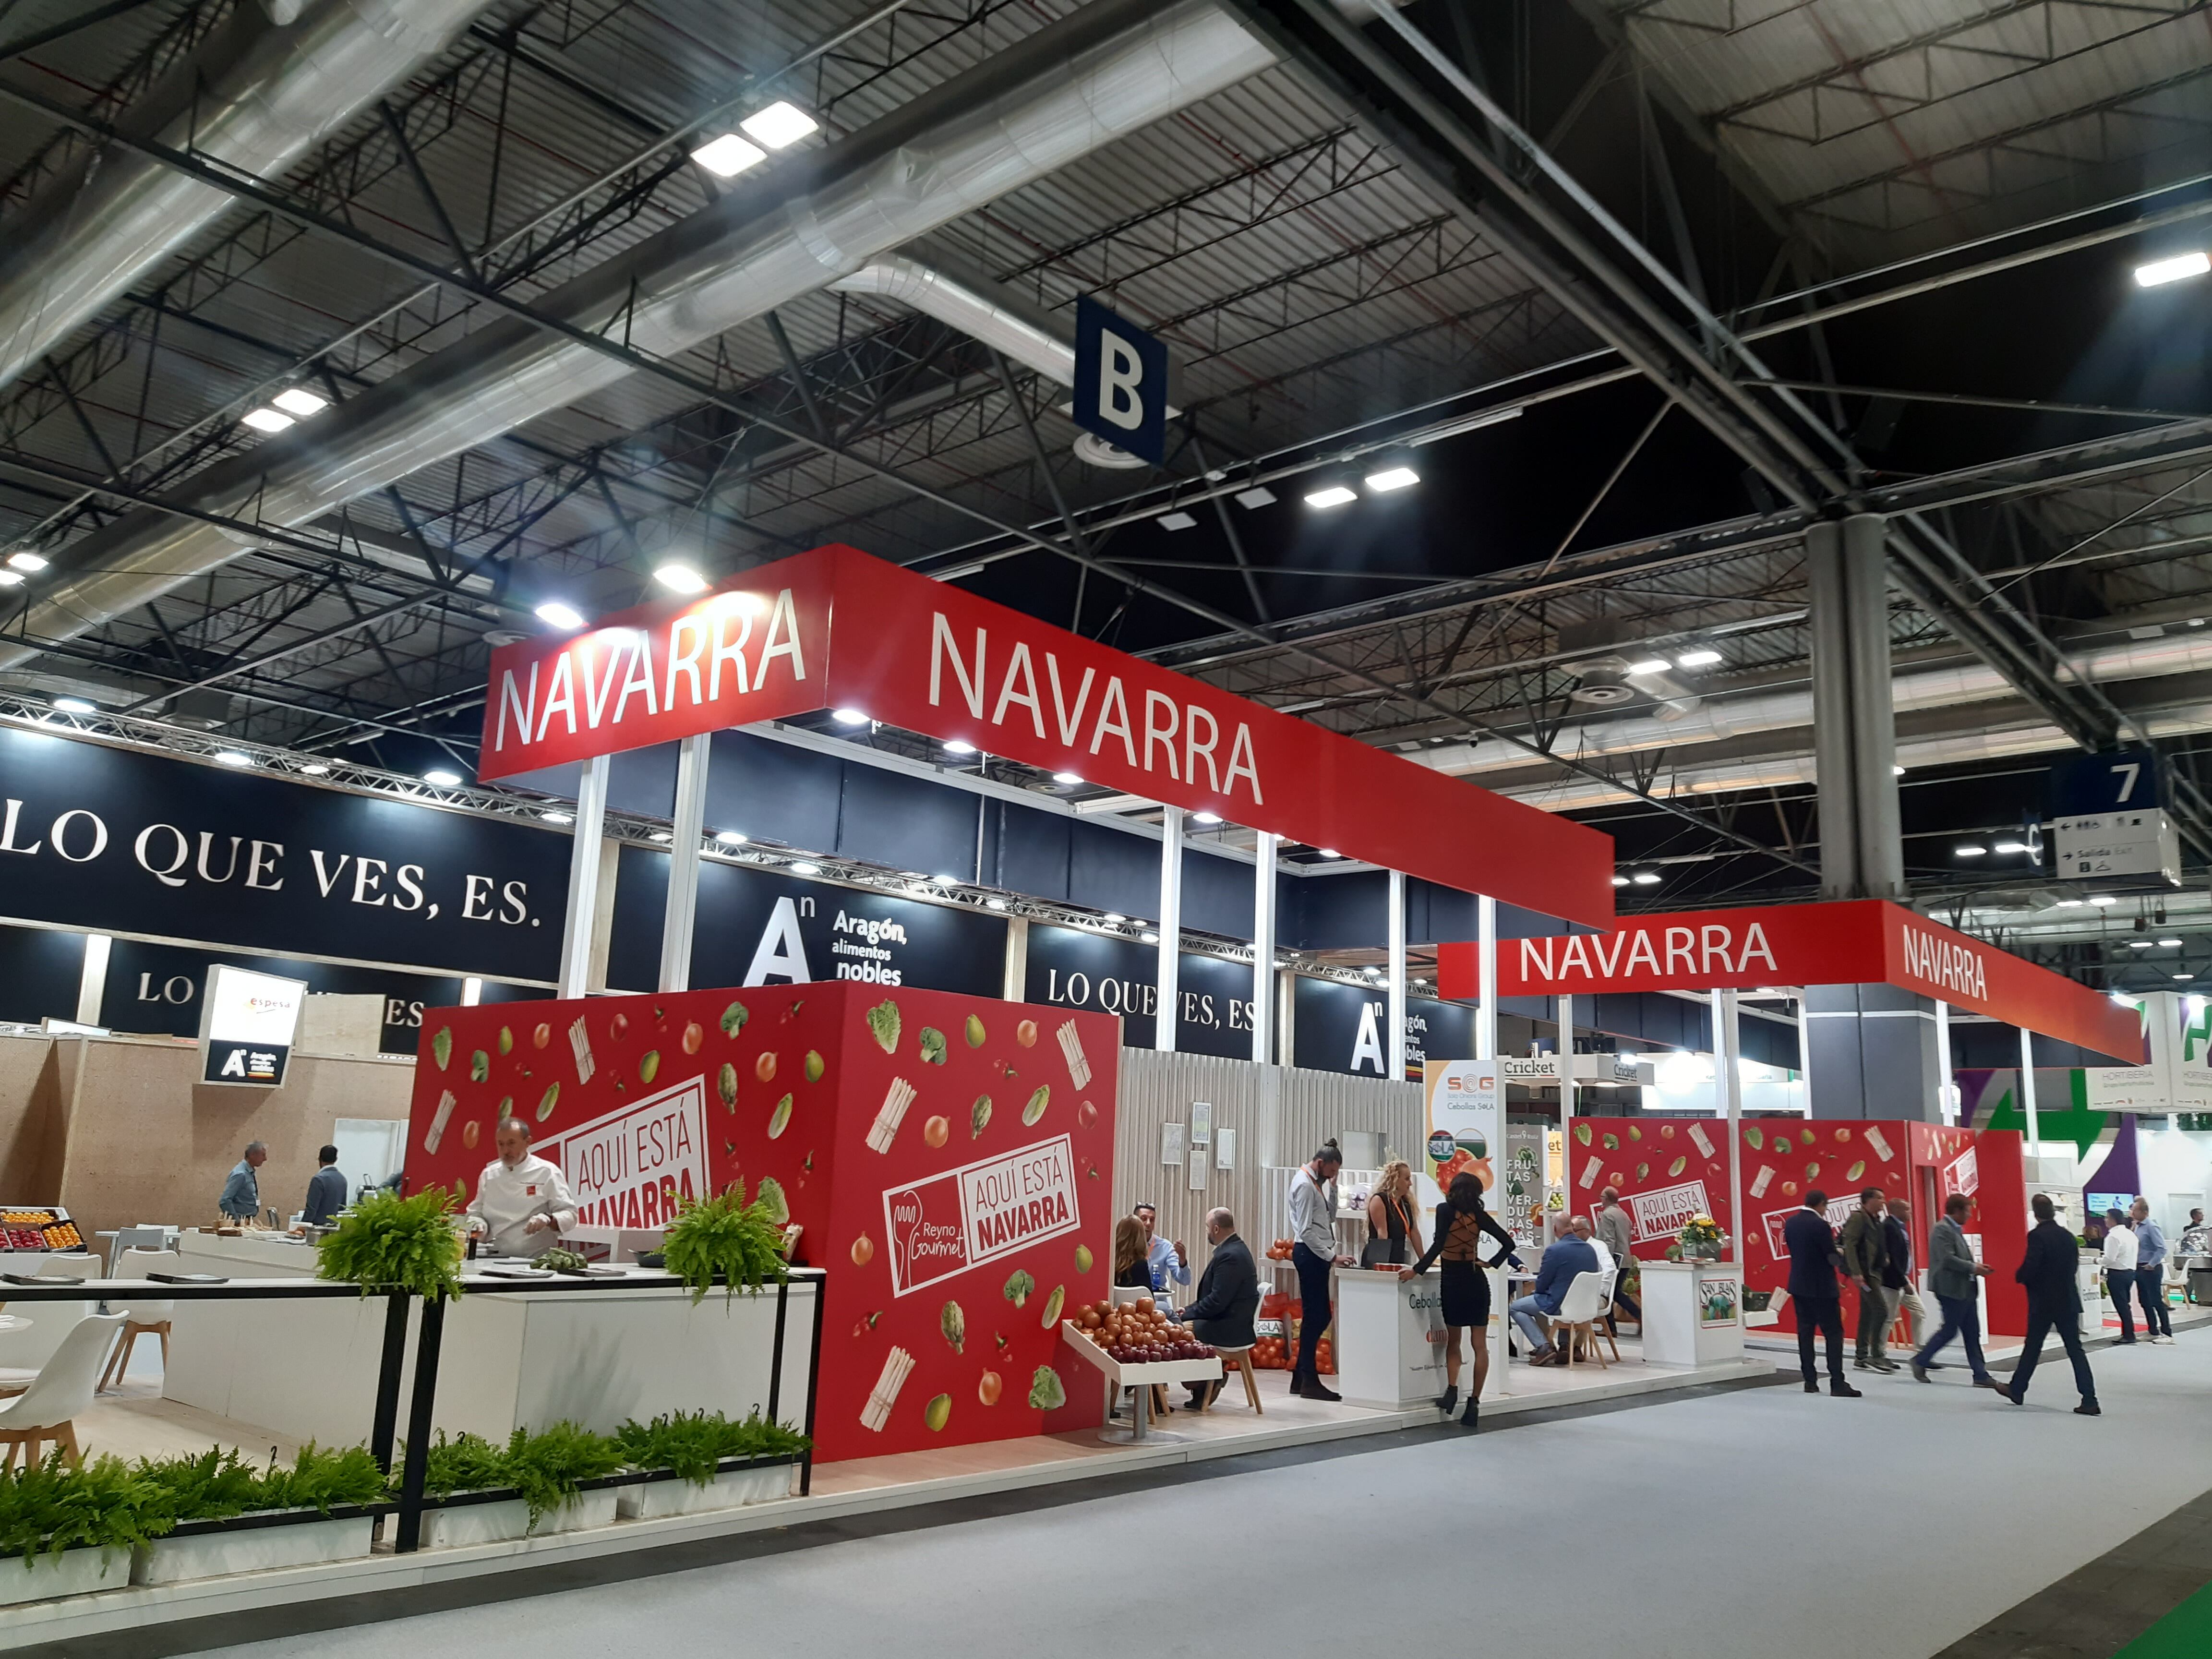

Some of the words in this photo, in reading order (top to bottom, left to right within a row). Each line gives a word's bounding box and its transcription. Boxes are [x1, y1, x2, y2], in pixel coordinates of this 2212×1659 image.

[1099, 327, 1143, 430] B
[495, 588, 806, 752] NAVARRA
[929, 612, 1263, 805] NAVARRA
[2112, 763, 2140, 803] 7
[2028, 823, 2041, 866] C
[0, 799, 108, 862] LO
[134, 823, 285, 890] QUE
[310, 849, 439, 920] VES,
[461, 874, 540, 927] ES.
[832, 909, 907, 945] Aragón,
[832, 938, 891, 961] alimentos
[1521, 923, 1778, 981] NAVARRA
[1903, 924, 1987, 1001] NAVARRA
[137, 972, 194, 1005] LO
[837, 960, 902, 986] nobles
[251, 998, 290, 1008] espesa
[1048, 969, 1090, 1005] LO
[1099, 977, 1156, 1016] QUE
[1505, 1060, 1555, 1073] Cricket
[1614, 1064, 1637, 1079] Cricket
[577, 1119, 628, 1195] AQUÍ
[637, 1096, 691, 1173] ESTÁ
[976, 1159, 1017, 1212] AQUÍ
[1022, 1146, 1064, 1196] ESTÁ
[1506, 1171, 1531, 1182] TAS
[1507, 1159, 1538, 1170] FRU-
[1507, 1183, 1514, 1193] Y
[1507, 1195, 1539, 1205] VER-
[1643, 1191, 1670, 1216] AQUÍ
[1671, 1186, 1701, 1210] ESTÁ
[977, 1191, 1070, 1252] NAVARRA
[1507, 1206, 1531, 1217] DU-
[1507, 1218, 1533, 1229] RAS
[1645, 1210, 1695, 1235] NAVARR
[912, 1227, 965, 1260] Gourmet
[924, 1222, 956, 1237] Reyno
[1409, 1292, 1442, 1309] Cebolla
